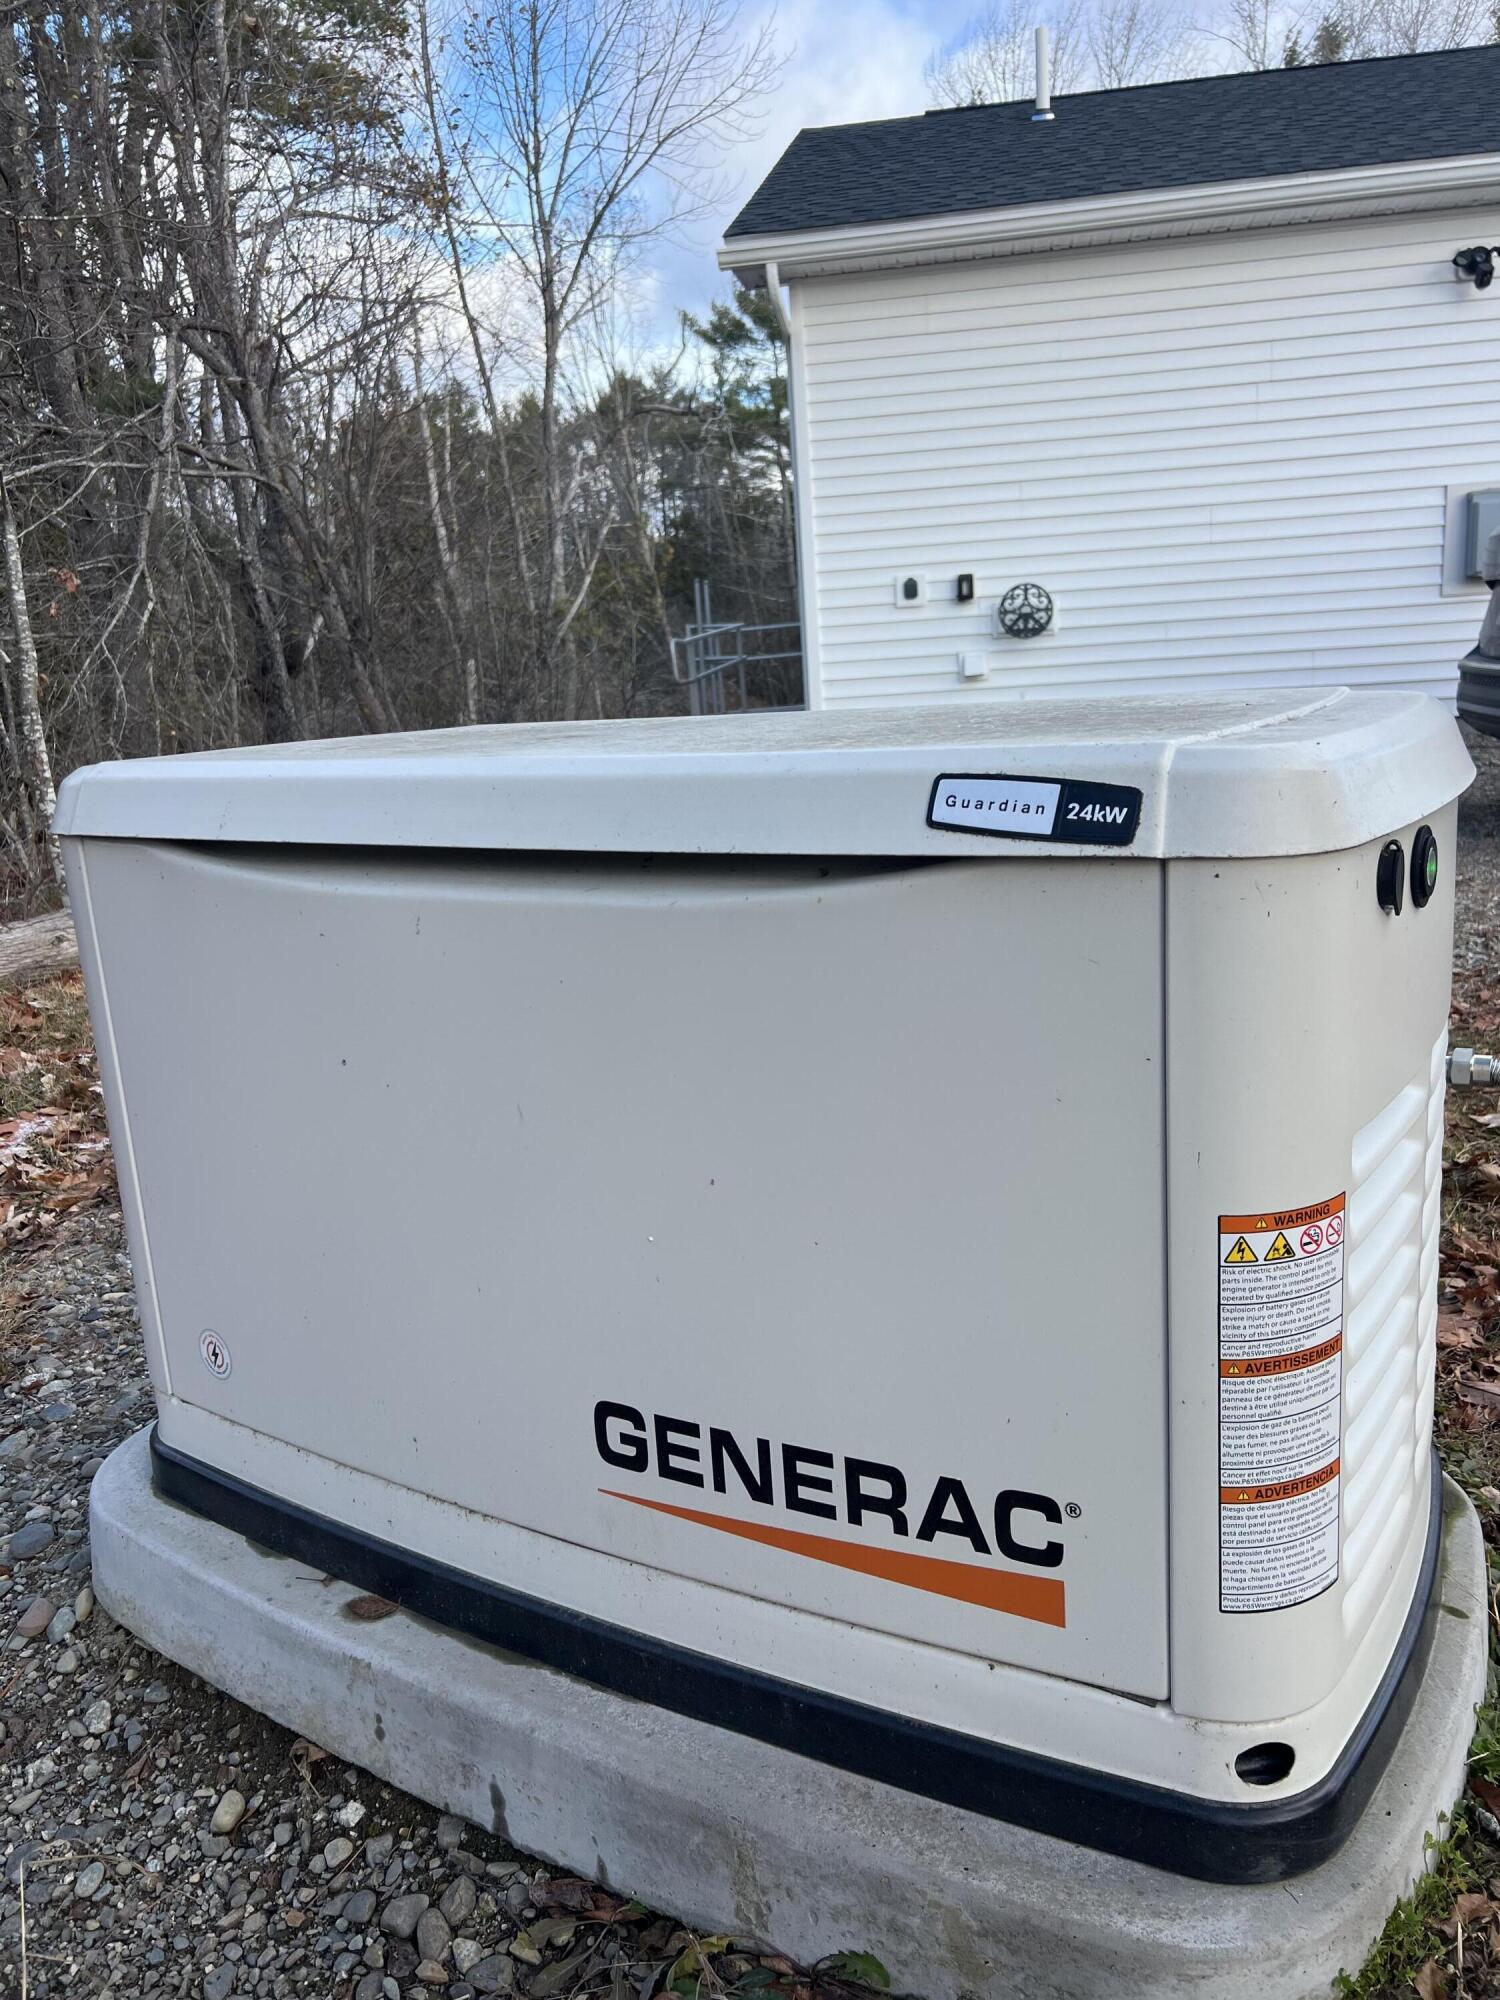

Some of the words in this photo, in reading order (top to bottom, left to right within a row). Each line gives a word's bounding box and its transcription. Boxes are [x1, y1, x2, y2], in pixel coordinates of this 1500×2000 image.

[945, 794, 1045, 815] Guardian
[1066, 803, 1128, 824] 24kW
[1273, 1204, 1330, 1227] WARNING
[1246, 1267, 1271, 1275] electric
[1222, 1286, 1246, 1294] engine
[1248, 1283, 1280, 1294] generator
[1222, 1294, 1253, 1303] operated
[1222, 1307, 1255, 1315] Explosion
[1245, 1340, 1339, 1374] AVERTISSEMENT
[1222, 1379, 1245, 1387] Risque
[1222, 1387, 1254, 1395] réparable
[1222, 1412, 1256, 1420] personnel
[1222, 1425, 1259, 1433] L'explosion
[1222, 1459, 1254, 1468] proximité
[1255, 1467, 1334, 1499] ADVERTENCIA
[1248, 1520, 1266, 1529] panel
[1238, 1528, 1270, 1536] destinado
[1236, 1536, 1264, 1546] personal
[1231, 1549, 1262, 1558] explosión
[1230, 1576, 1246, 1584] haga
[1247, 1574, 1270, 1582] chispas
[1222, 1582, 1273, 1592] compartimiento
